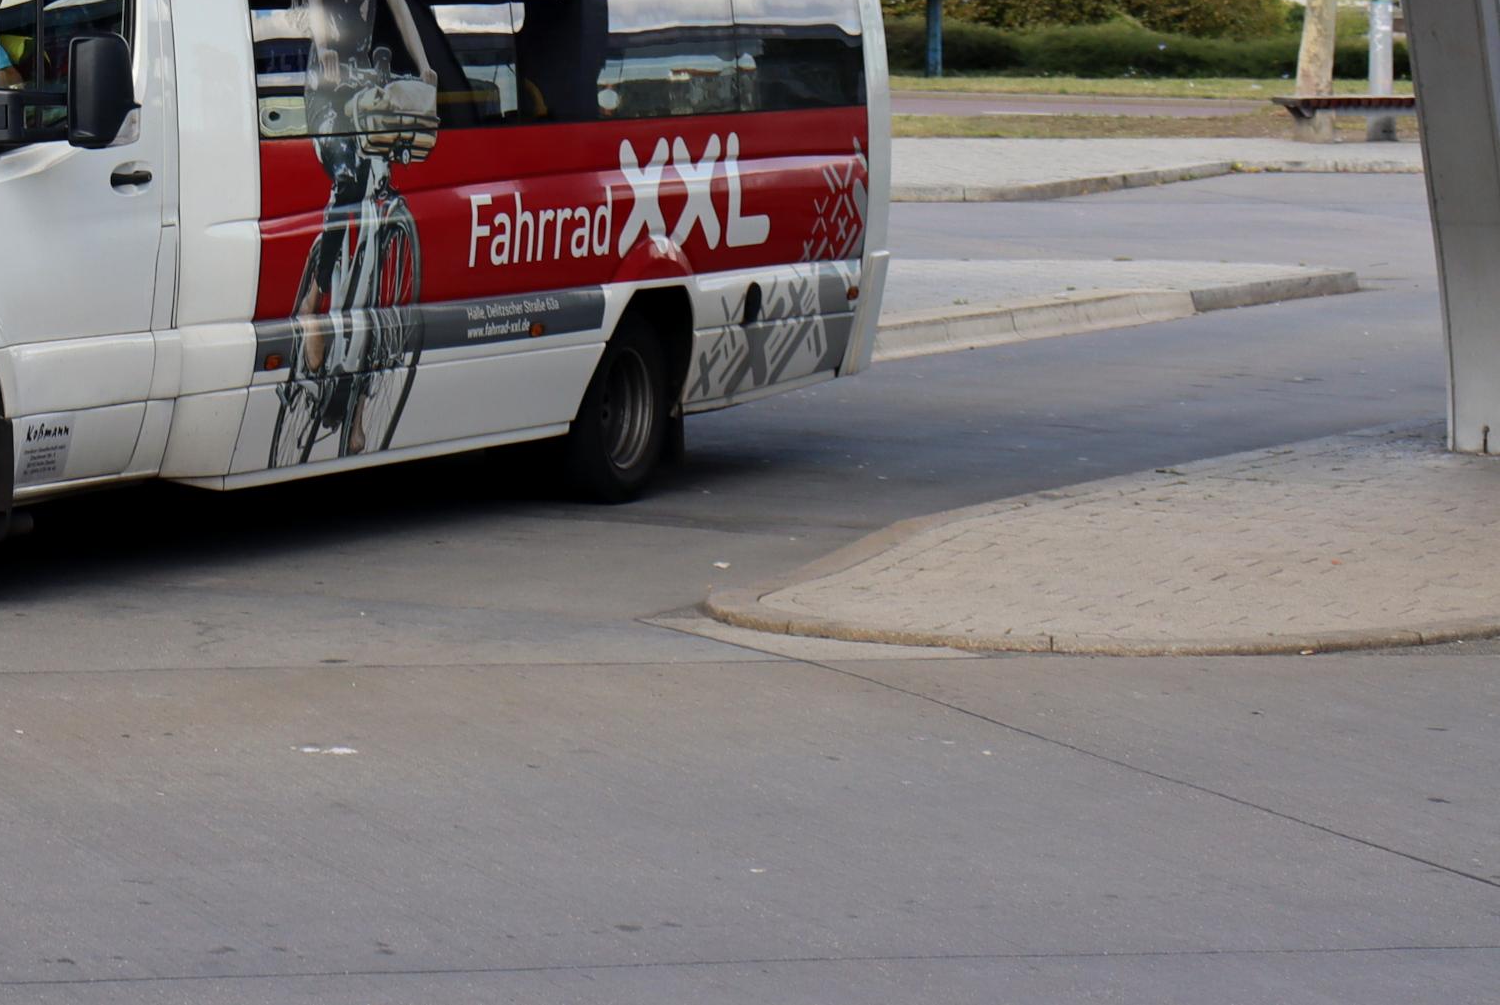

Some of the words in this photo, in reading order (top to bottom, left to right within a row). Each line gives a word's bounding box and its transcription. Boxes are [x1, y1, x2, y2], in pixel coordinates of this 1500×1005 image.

[468, 185, 614, 268] Fahrrad
[618, 132, 771, 259] XXL
[523, 299, 546, 314] Straße
